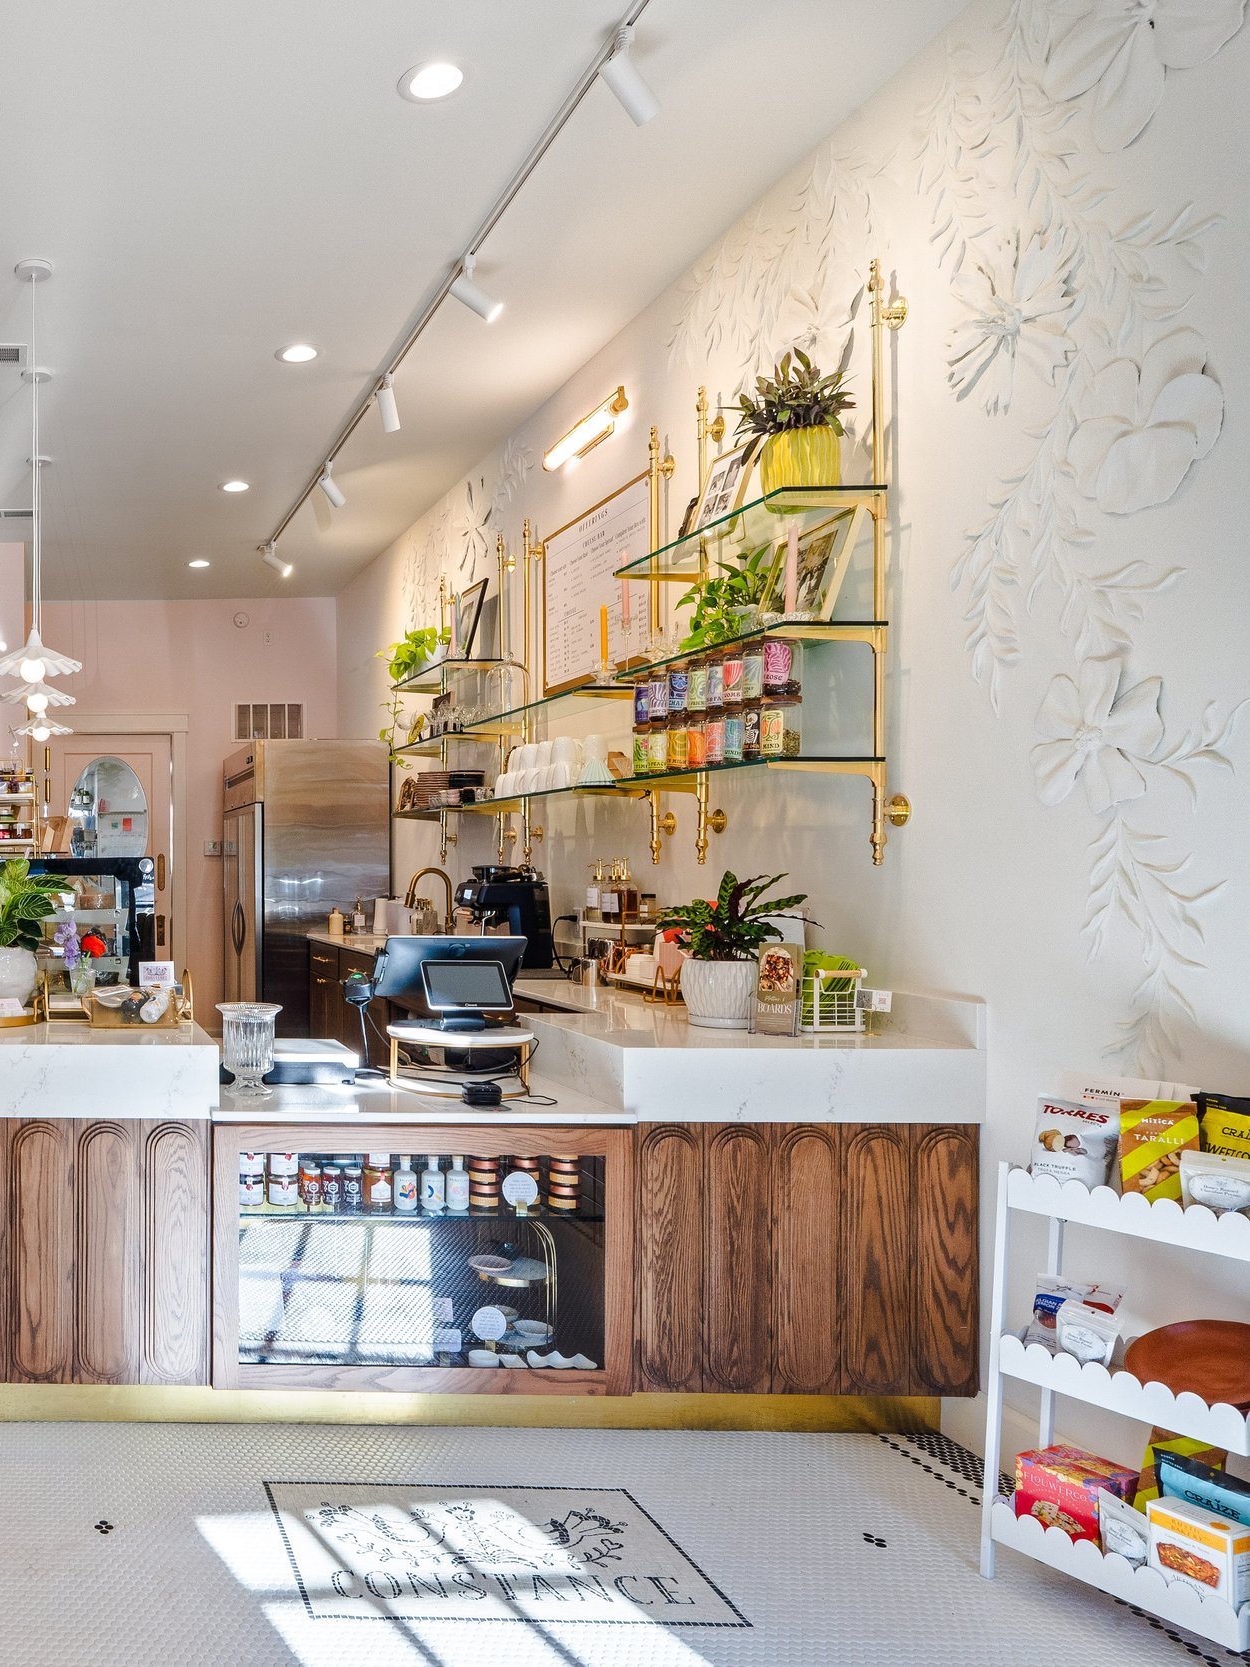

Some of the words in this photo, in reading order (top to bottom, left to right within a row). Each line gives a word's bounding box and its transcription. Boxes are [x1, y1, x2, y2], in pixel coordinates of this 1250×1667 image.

[578, 508, 608, 533] OFFERINGS
[757, 1003, 792, 1015] BOARDS
[1134, 1133, 1184, 1145] TARALLI
[1051, 1163, 1076, 1171] TRUFFLE
[330, 1568, 697, 1606] CONSTANCE
